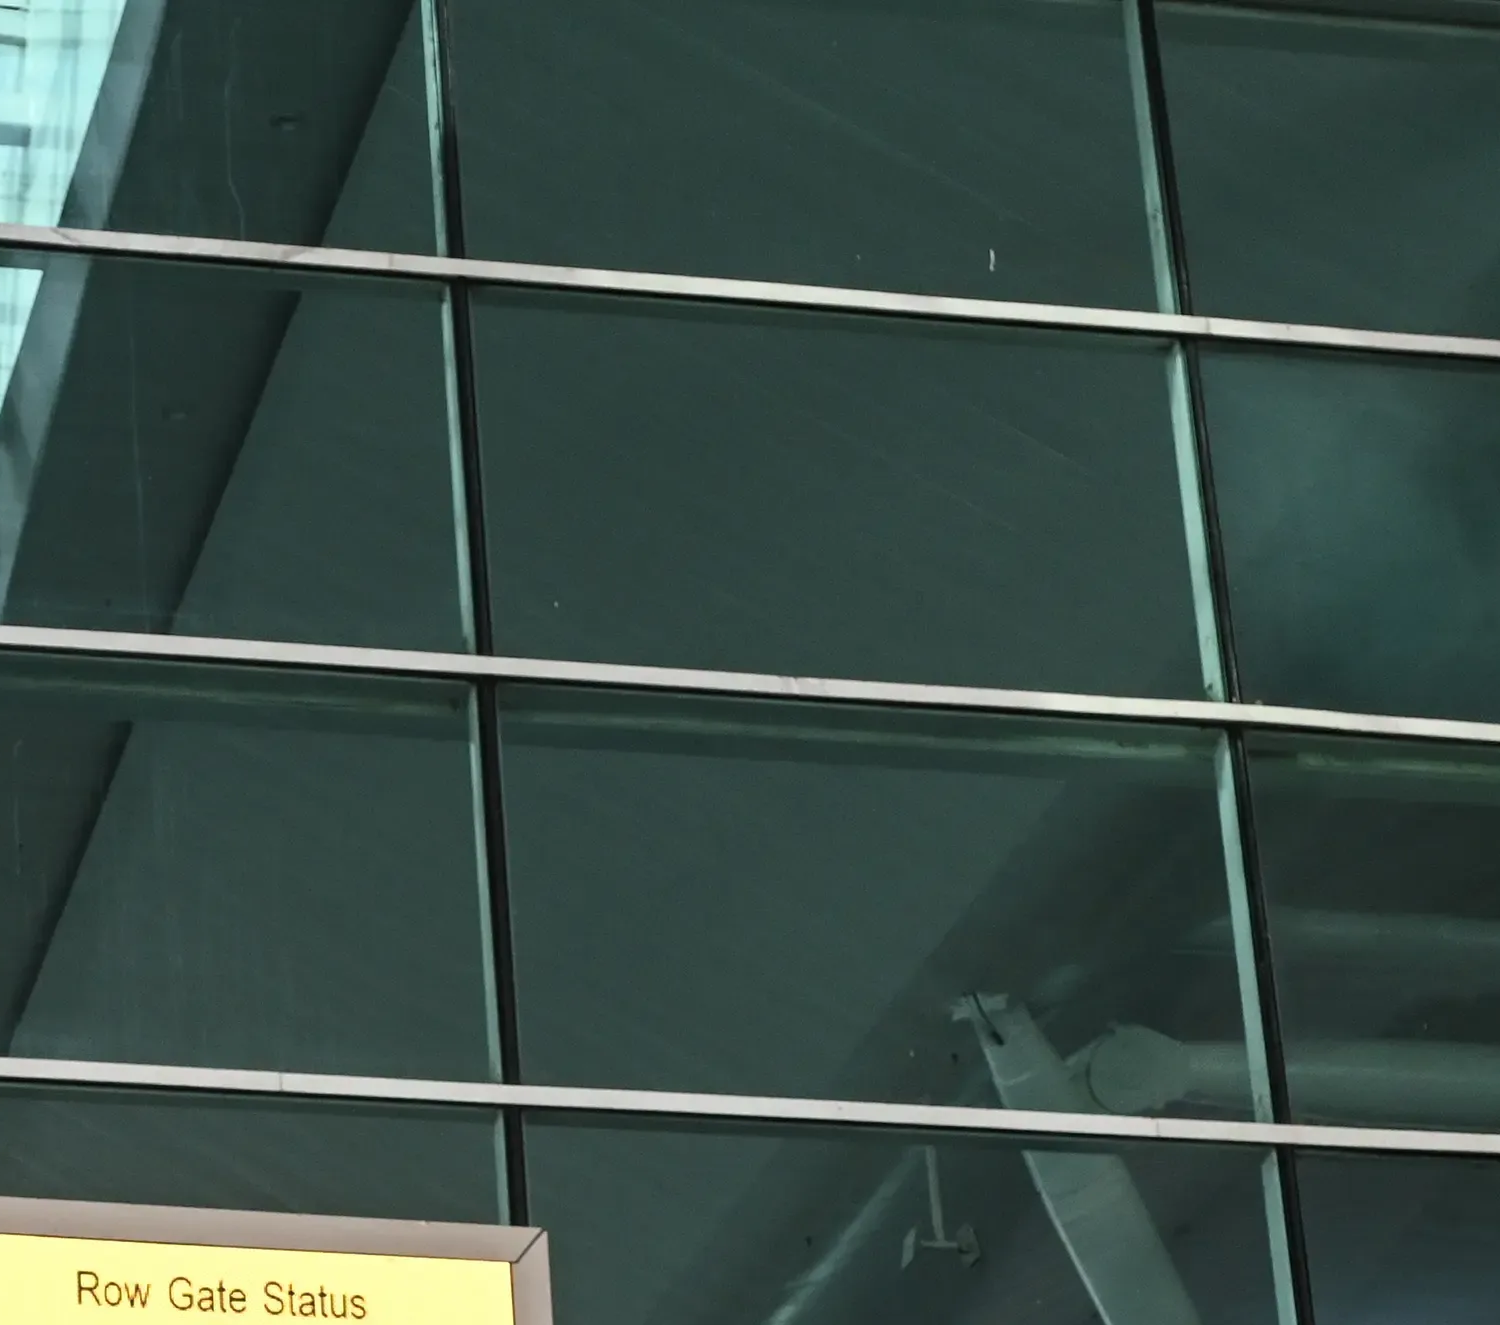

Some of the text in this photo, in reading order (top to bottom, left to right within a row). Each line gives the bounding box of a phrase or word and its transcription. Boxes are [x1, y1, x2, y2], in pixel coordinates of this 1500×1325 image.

[77, 1271, 149, 1308] Row
[169, 1277, 246, 1313] Gate
[264, 1282, 366, 1320] Status
